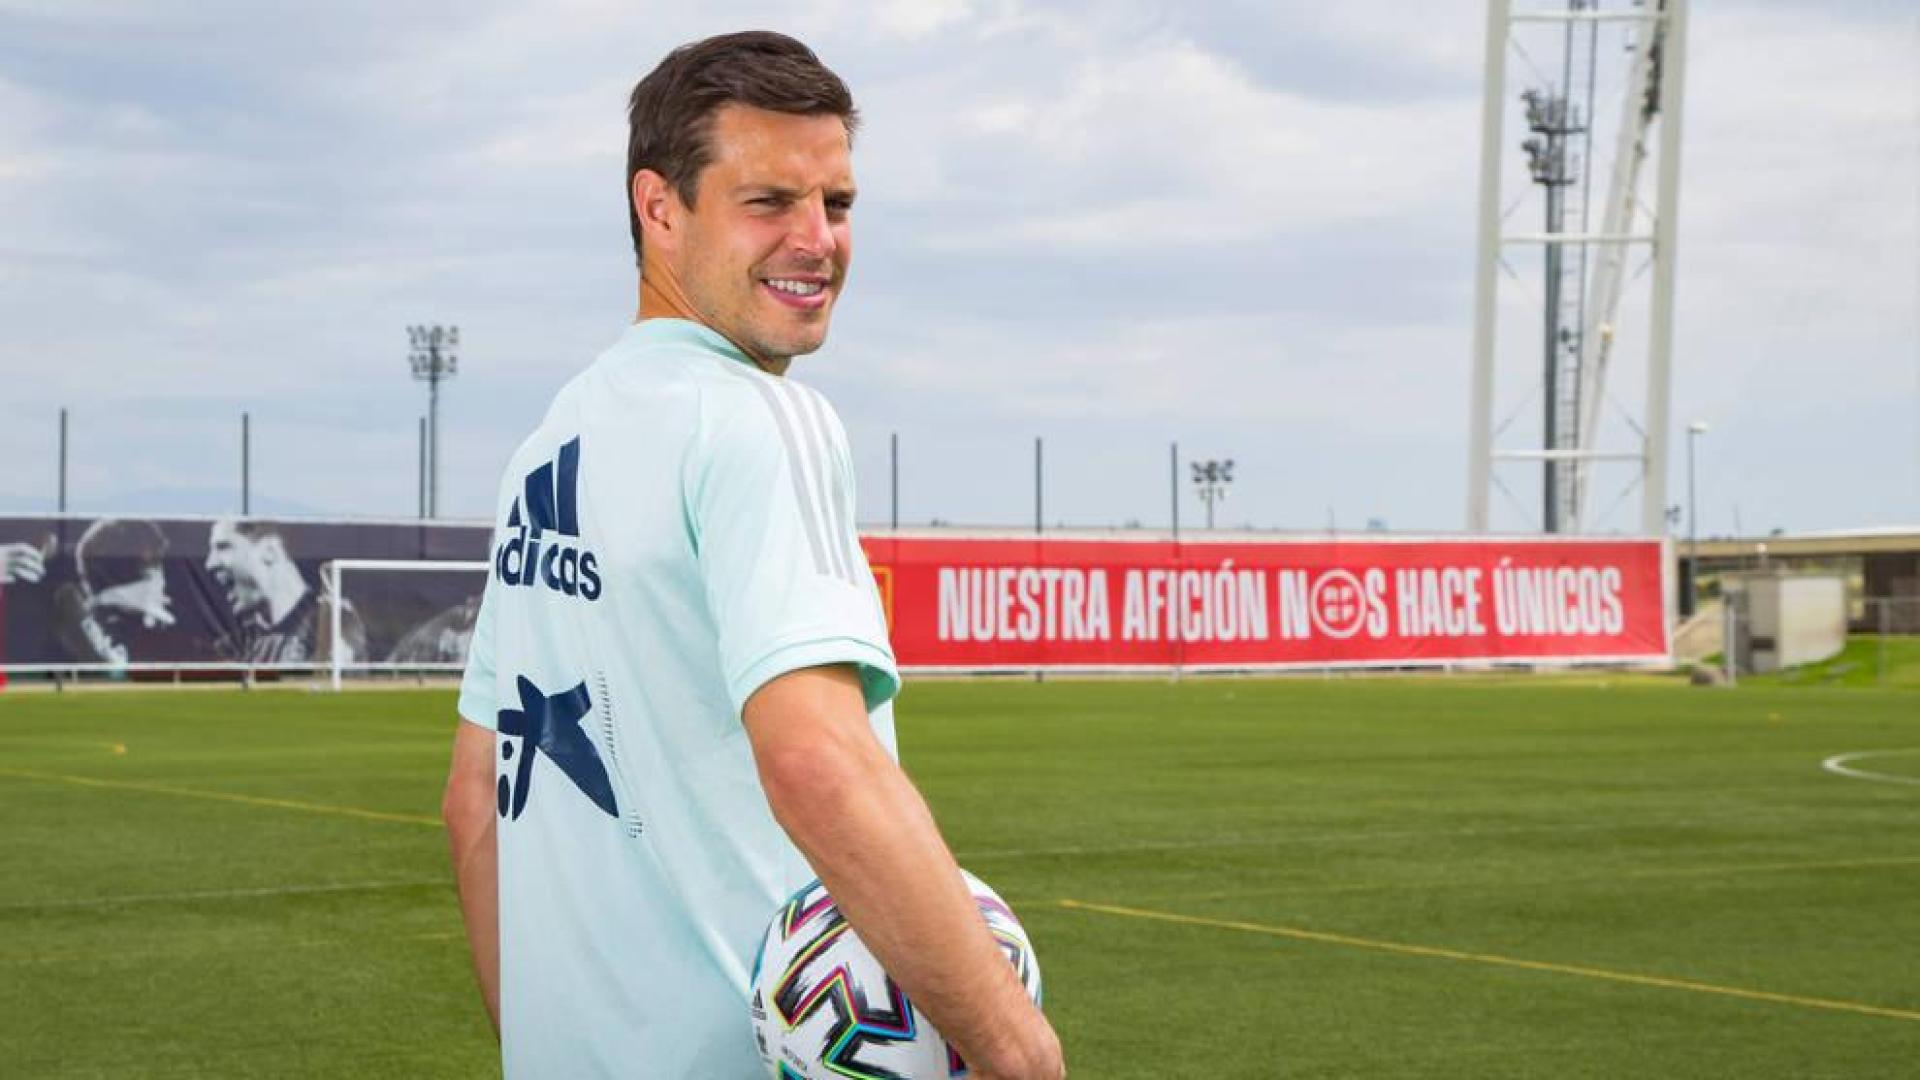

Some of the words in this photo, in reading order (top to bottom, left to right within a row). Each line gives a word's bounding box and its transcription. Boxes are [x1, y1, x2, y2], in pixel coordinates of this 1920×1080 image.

[938, 567, 1111, 641] NUESTRA
[1122, 559, 1269, 641] AFICIÓN
[1396, 567, 1486, 638] HACE
[1493, 557, 1623, 636] ÚNICOS
